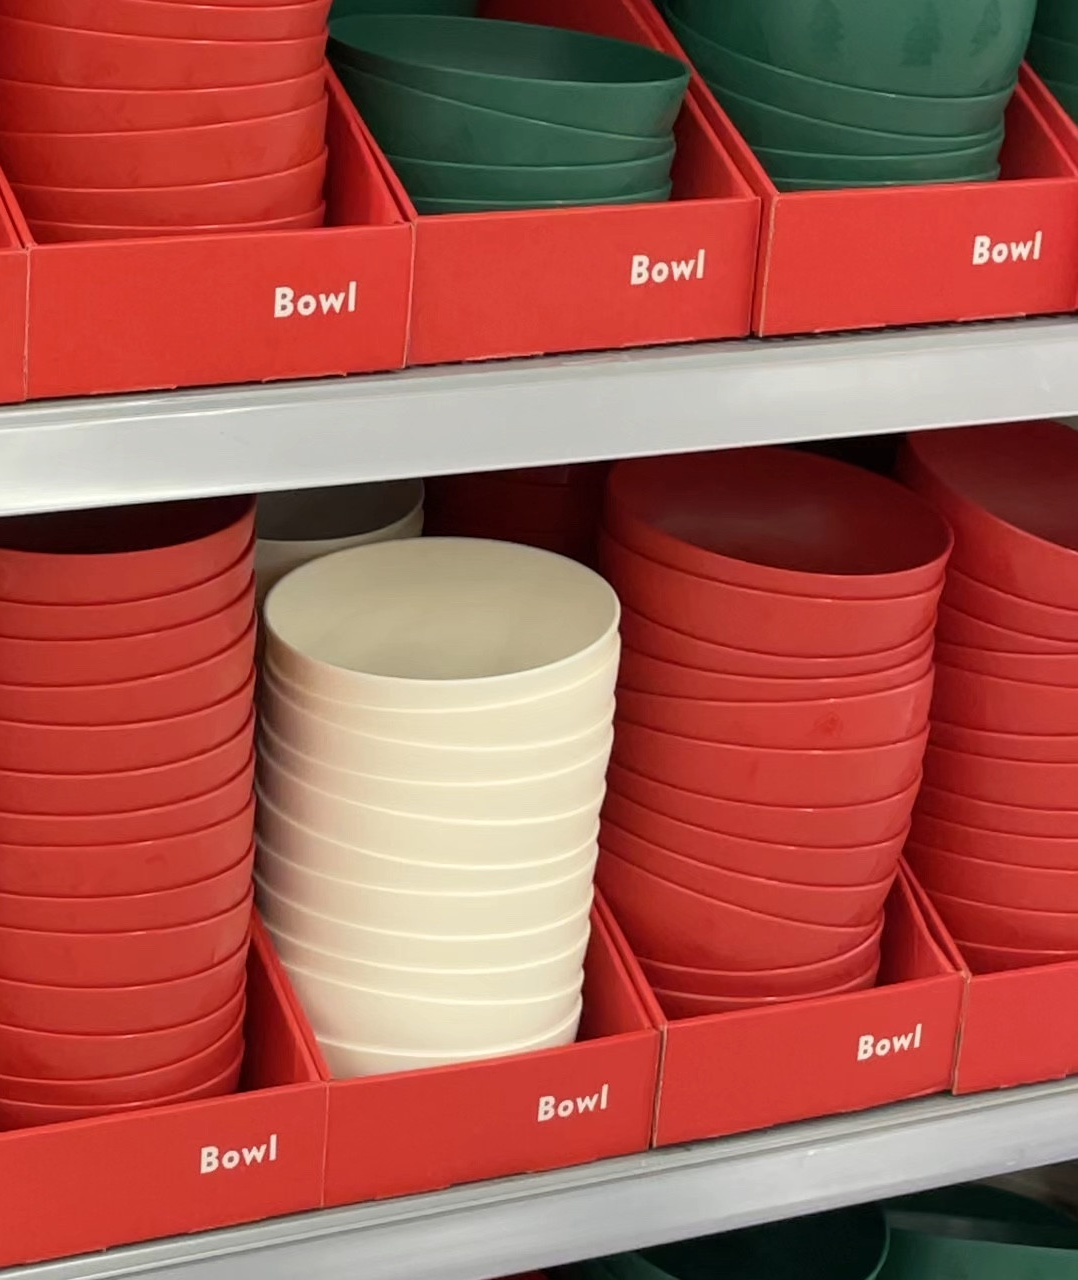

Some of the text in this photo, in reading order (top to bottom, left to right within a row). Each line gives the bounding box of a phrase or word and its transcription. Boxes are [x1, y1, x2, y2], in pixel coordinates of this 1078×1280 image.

[972, 230, 1043, 265] Bowl
[630, 248, 706, 285] Bowl
[273, 281, 357, 318] Bowl
[857, 1023, 922, 1061] Bowl
[537, 1083, 609, 1122] Bowl
[200, 1134, 277, 1174] Bowl
